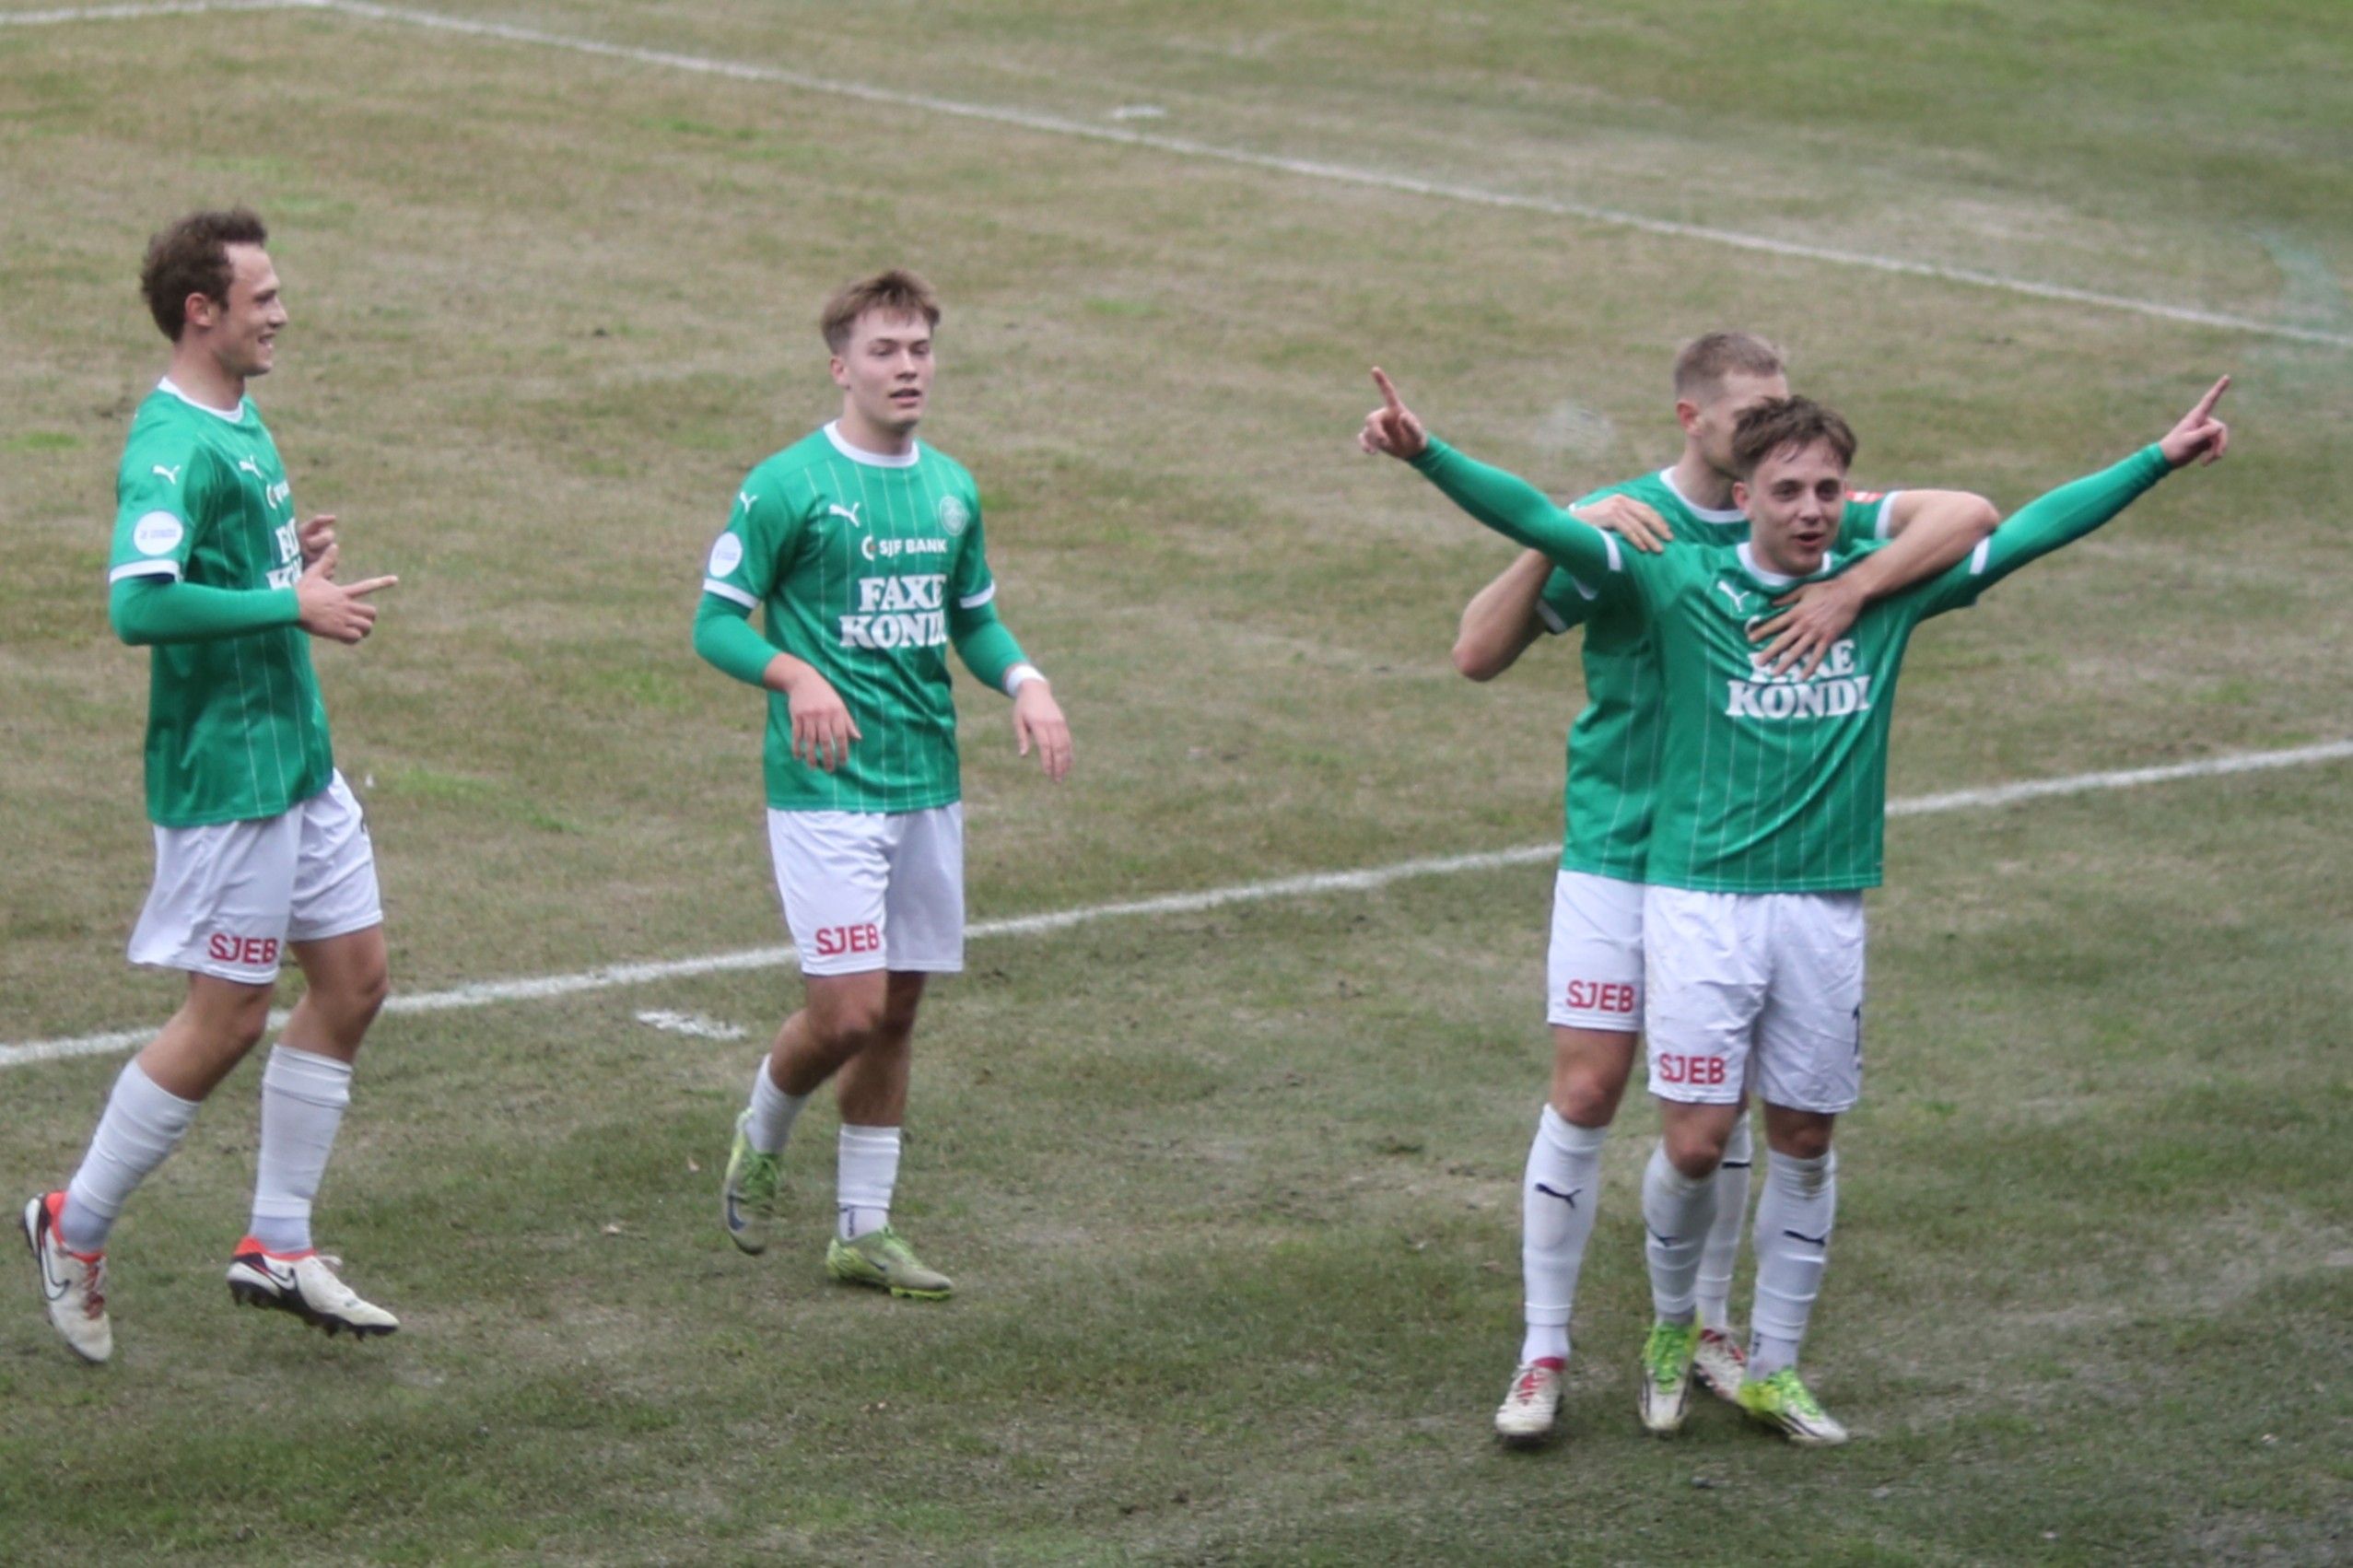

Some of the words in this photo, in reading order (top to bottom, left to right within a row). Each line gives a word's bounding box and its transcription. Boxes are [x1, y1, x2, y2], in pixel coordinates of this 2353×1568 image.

[879, 538, 902, 557] SJF
[905, 538, 948, 554] BANK
[1724, 674, 1871, 720] KONDI
[209, 932, 278, 964] SJEB
[815, 922, 879, 955] SJEB
[1566, 979, 1634, 1012] SJEB
[1659, 1053, 1725, 1084] SJEB
